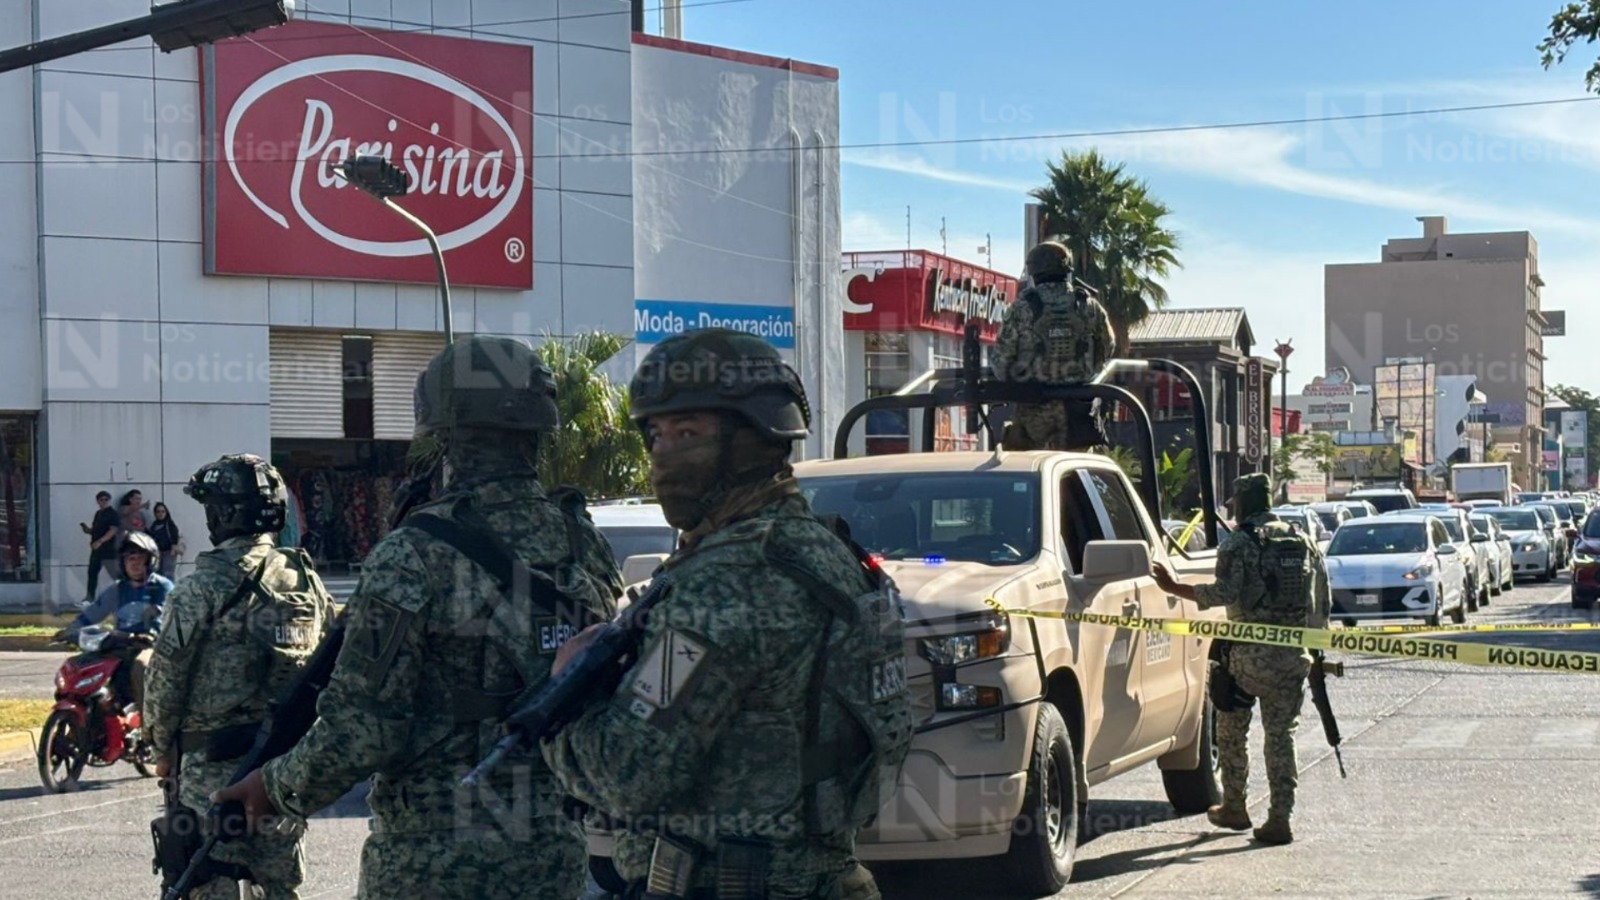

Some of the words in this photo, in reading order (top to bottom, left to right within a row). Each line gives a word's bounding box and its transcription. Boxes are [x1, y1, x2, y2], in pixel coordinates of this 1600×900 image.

[634, 308, 684, 333] Moda
[699, 311, 793, 337] Decoración
[1249, 364, 1257, 386] EL
[1248, 391, 1258, 457] BRONCO
